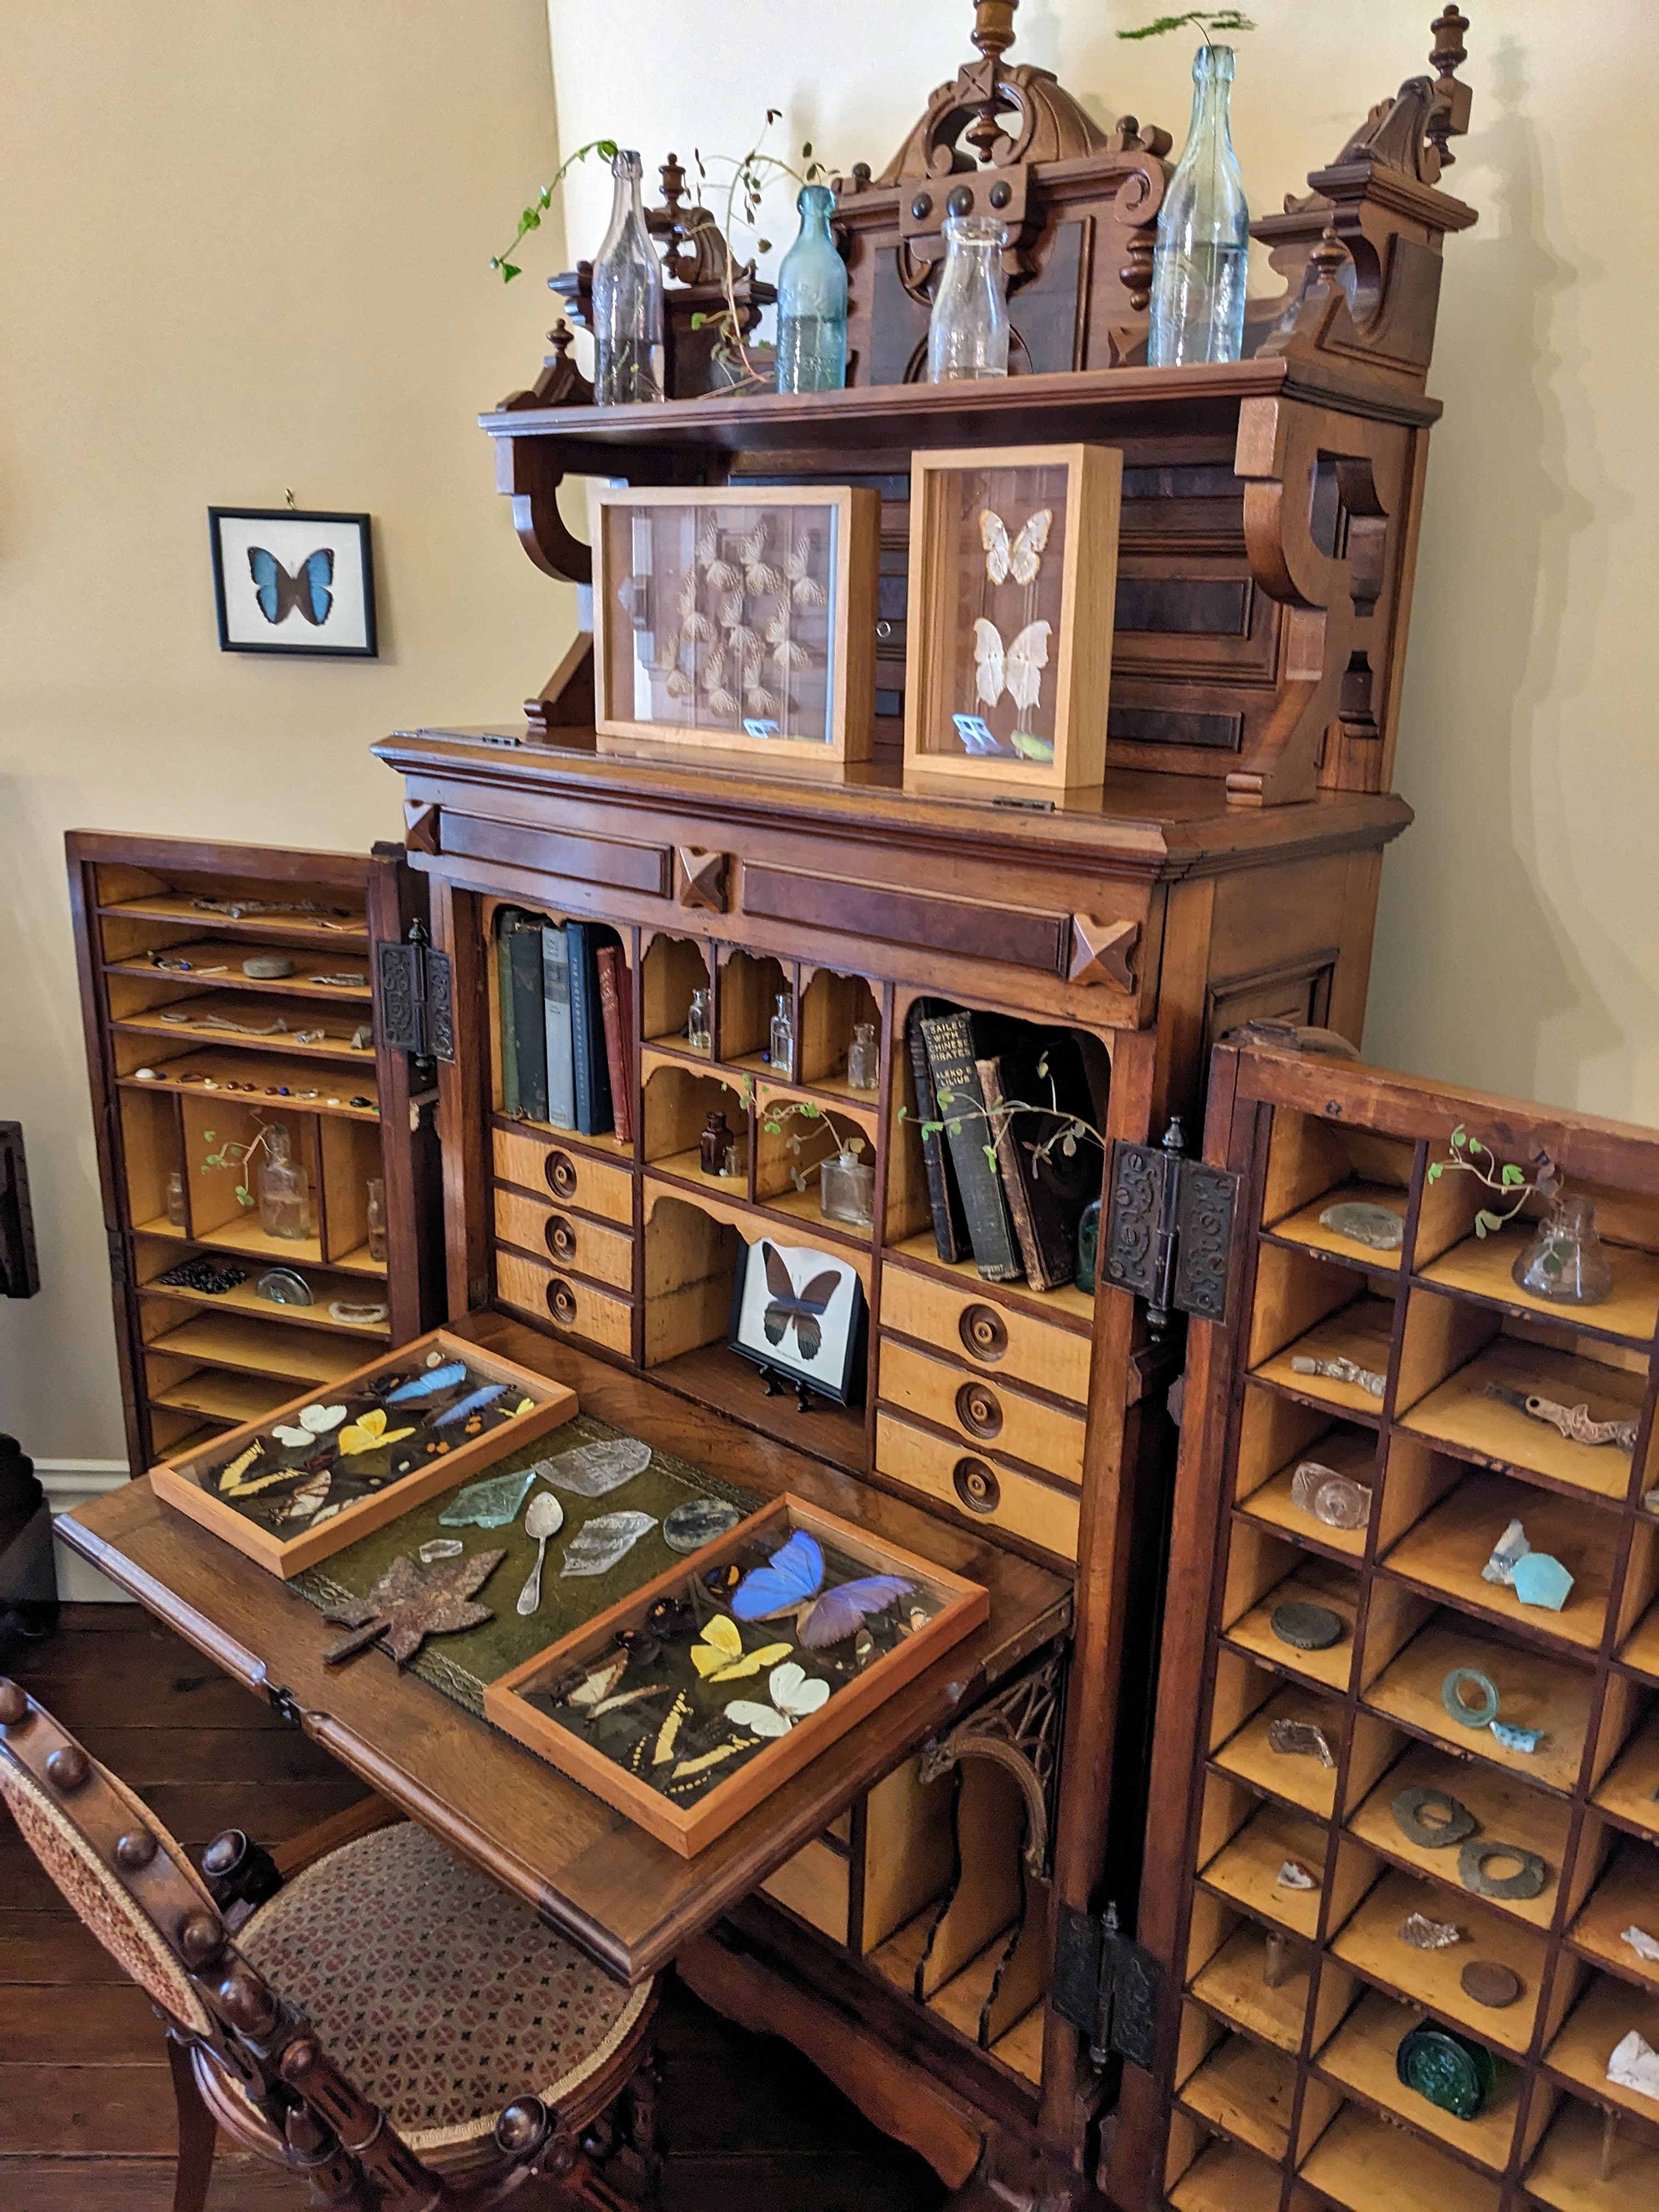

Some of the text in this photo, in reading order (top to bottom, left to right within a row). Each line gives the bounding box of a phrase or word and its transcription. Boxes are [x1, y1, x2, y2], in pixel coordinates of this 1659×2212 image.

[930, 1020, 966, 1035] SAILED
[933, 1031, 959, 1043] WITH
[929, 1038, 968, 1053] CHINESE
[930, 1048, 971, 1062] PIRATES
